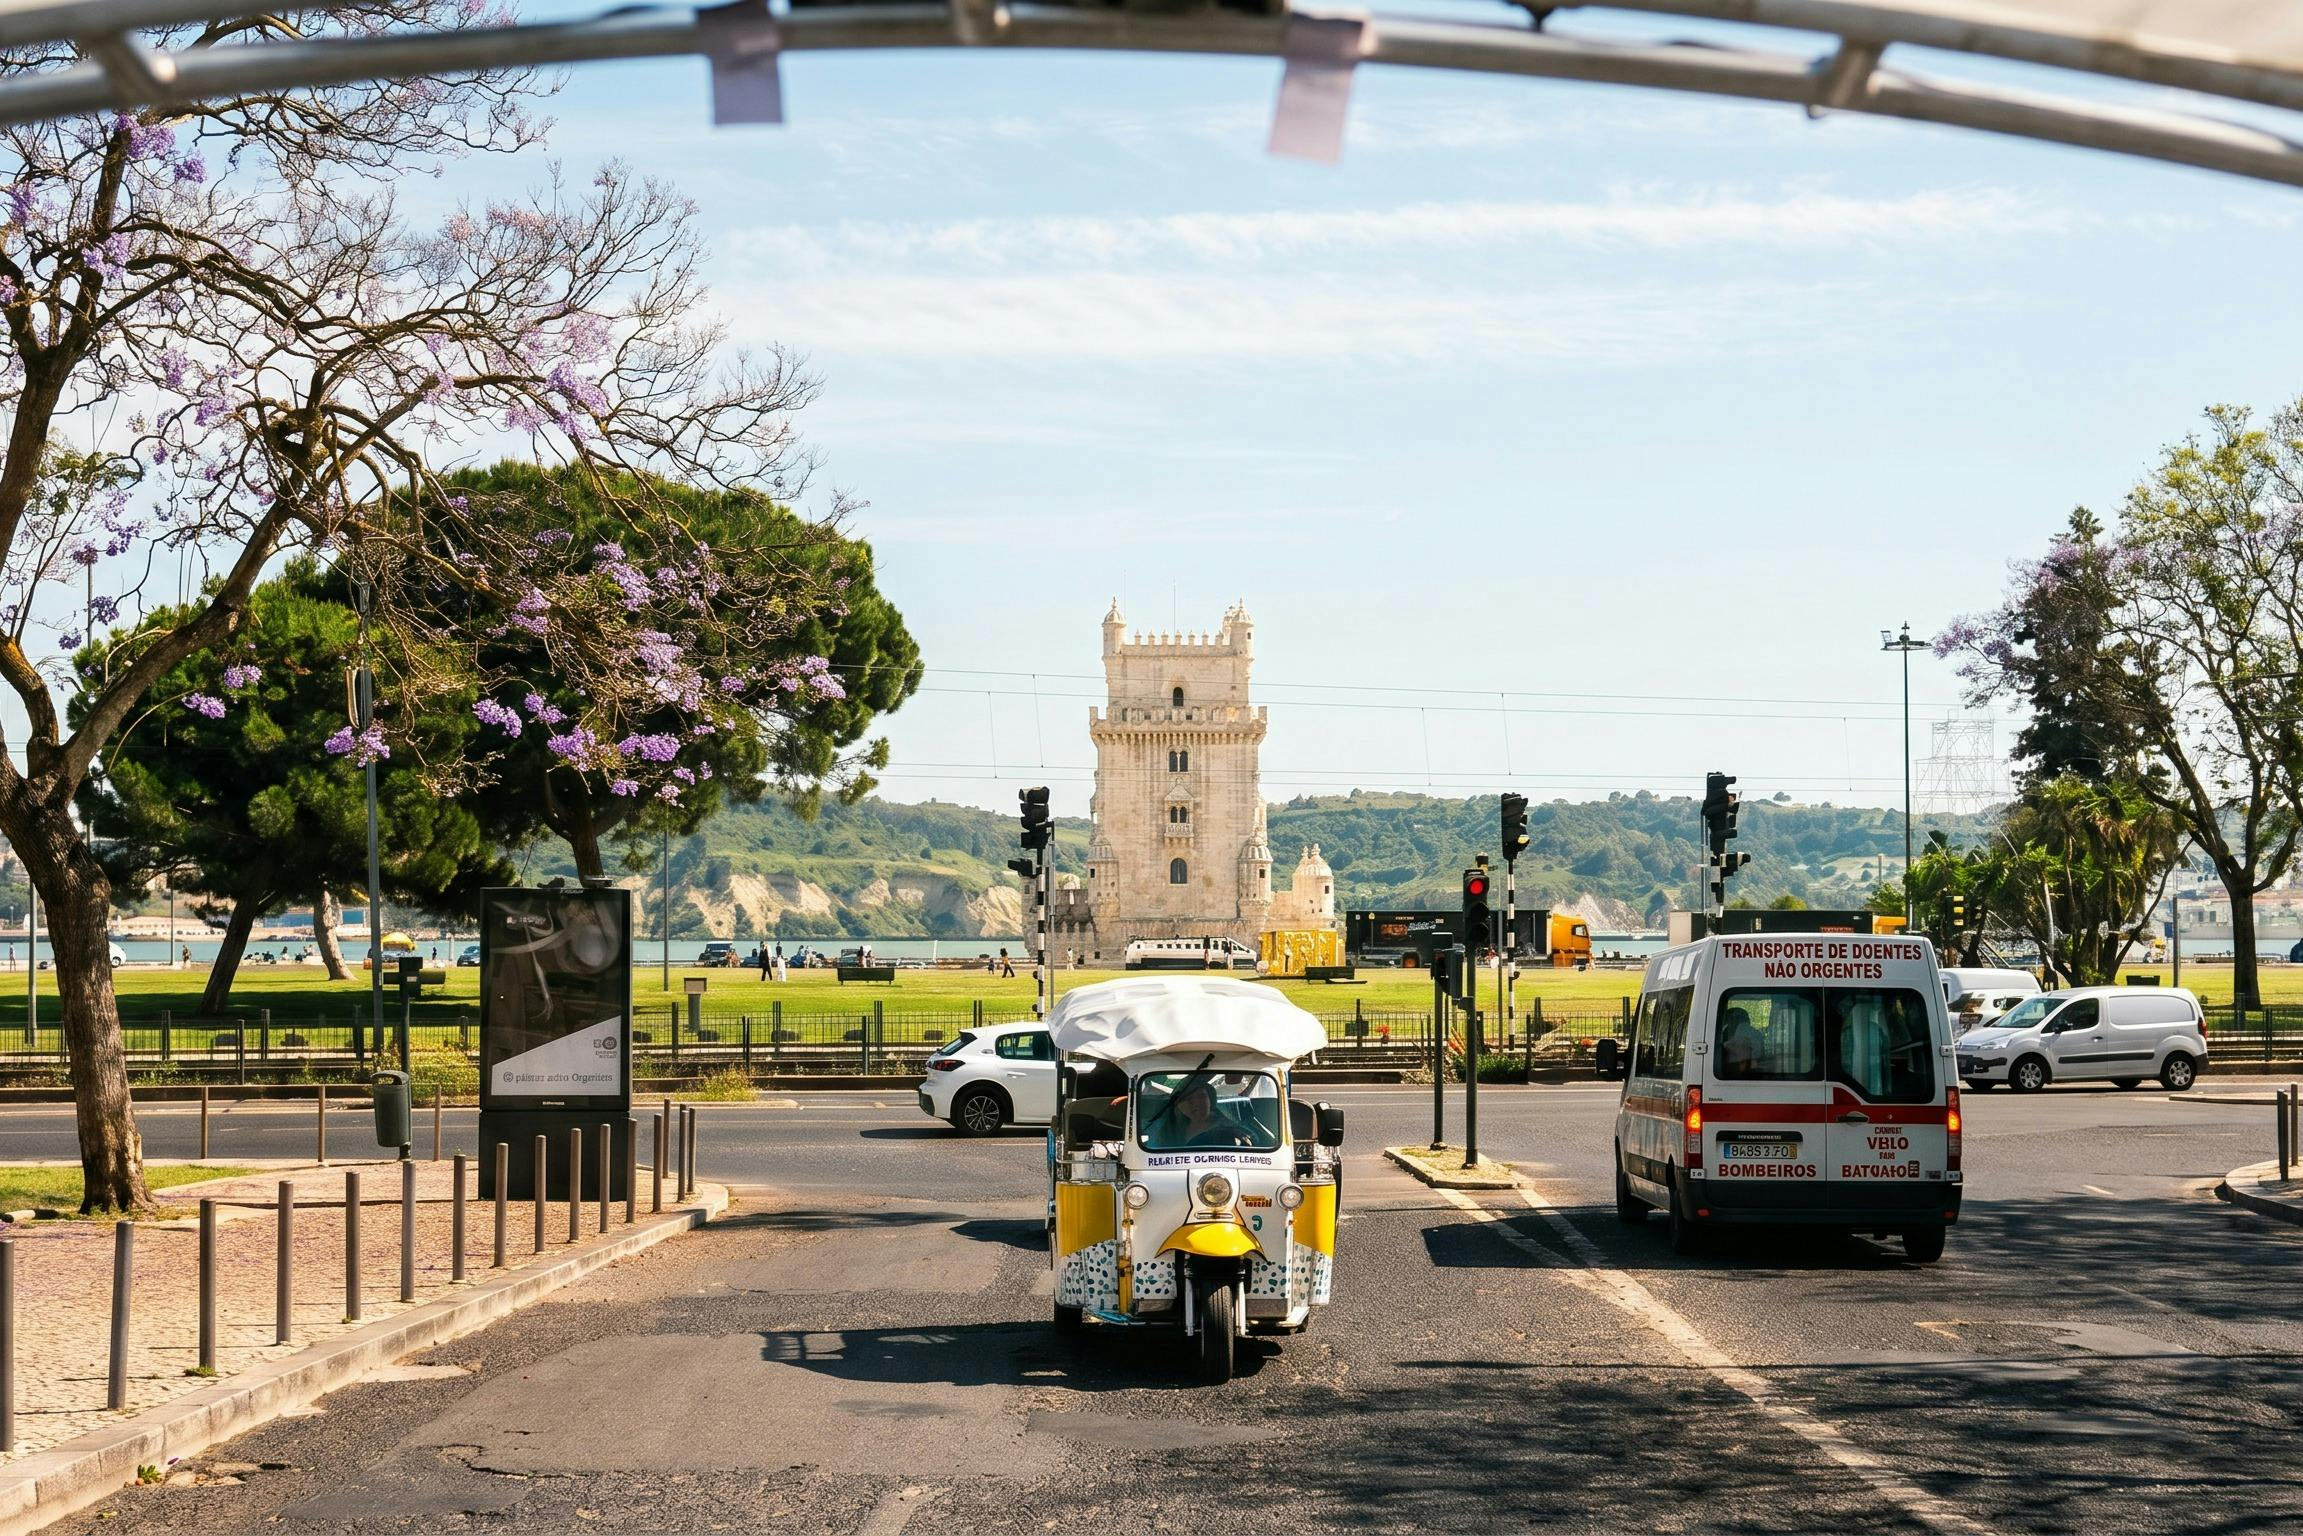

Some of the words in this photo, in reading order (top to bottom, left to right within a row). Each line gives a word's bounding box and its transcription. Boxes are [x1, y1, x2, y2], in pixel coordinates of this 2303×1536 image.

[1722, 942, 1824, 959] TRANSPORTE
[1828, 943, 1848, 959] DE
[1852, 943, 1922, 960] DOENTES
[1800, 962, 1883, 979] ORGENTES
[1718, 1163, 1817, 1178] BOMBEIROS
